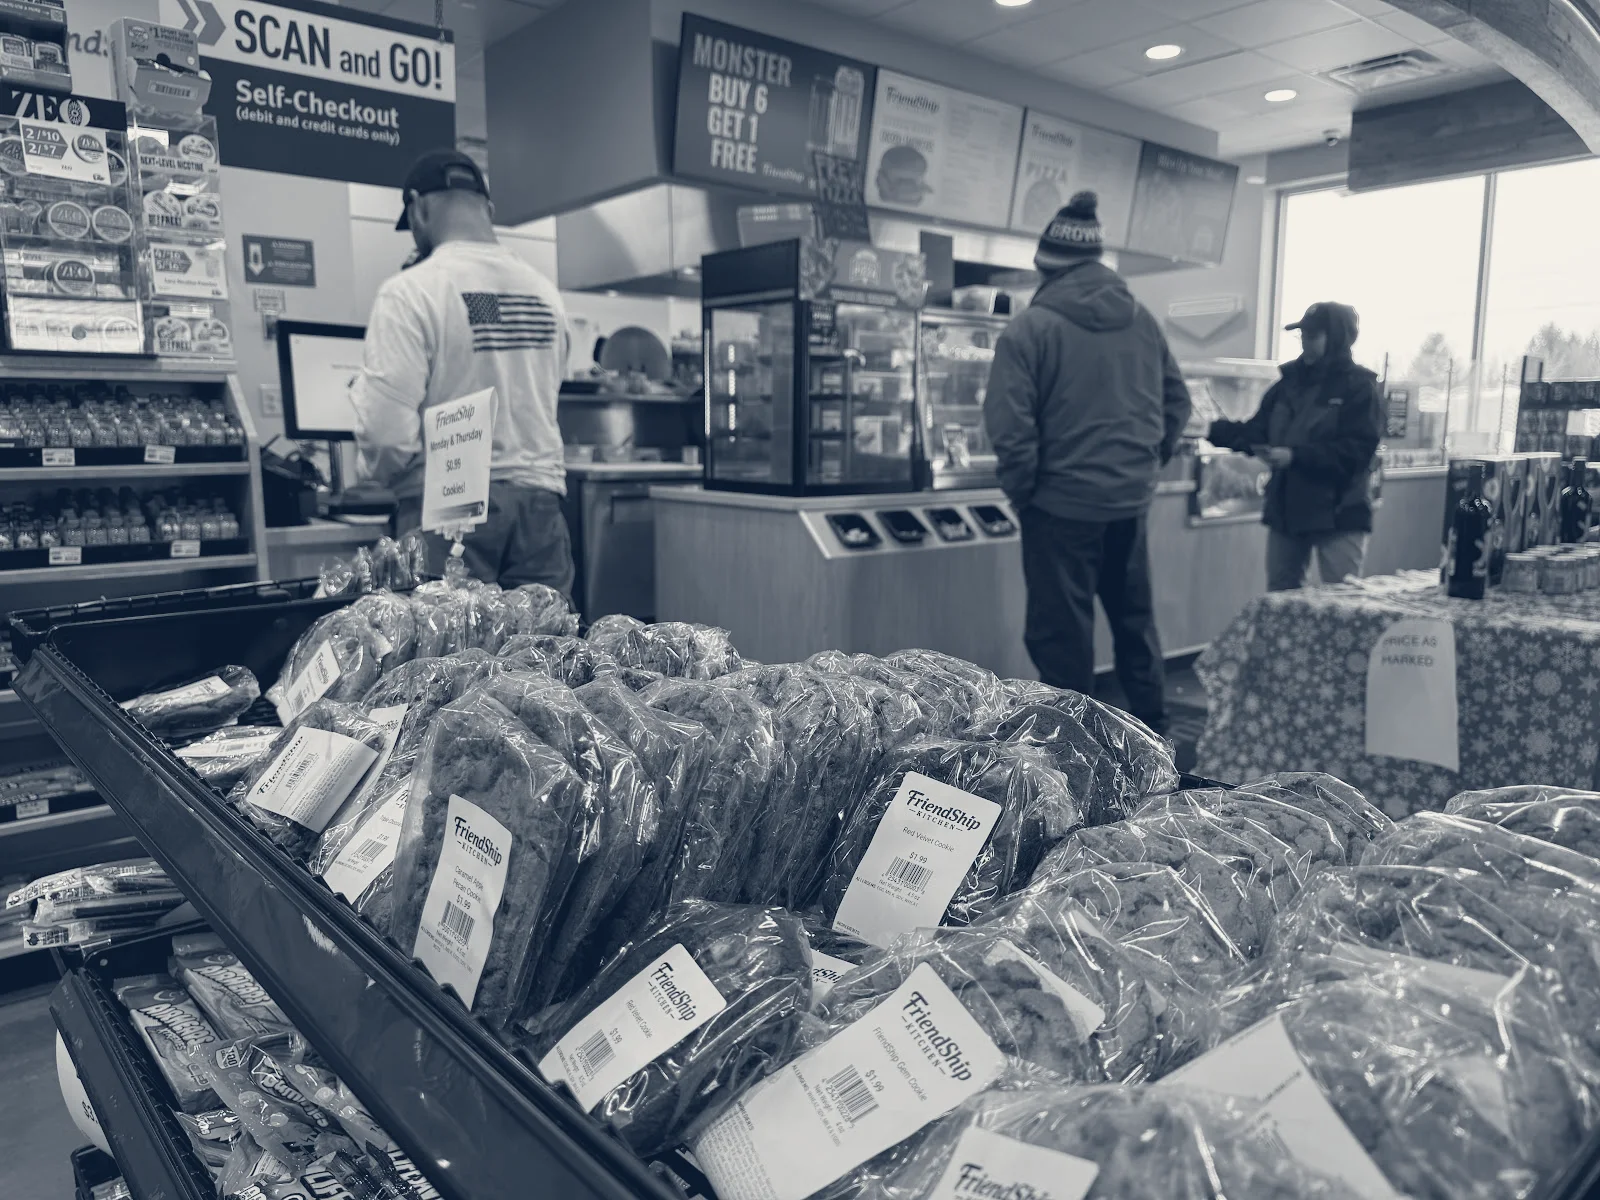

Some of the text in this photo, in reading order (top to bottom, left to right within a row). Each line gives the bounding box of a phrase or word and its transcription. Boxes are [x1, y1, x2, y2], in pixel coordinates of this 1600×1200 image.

[234, 9, 442, 90] SCAN and GO!
[693, 32, 792, 87] MONSTER
[236, 78, 400, 128] Self-Checkout
[708, 72, 768, 114] BUY 6
[886, 86, 940, 114] FriendShip
[236, 105, 400, 146] (debit and credit cards only)
[707, 105, 758, 144] GET 1
[177, 162, 204, 172] NICOTINE
[710, 138, 758, 174] FREE
[436, 404, 475, 430] FriendShip
[430, 430, 483, 453] Monday & Thursday
[442, 482, 466, 496] Cookies!
[1381, 654, 1434, 667] MARKED
[906, 789, 981, 830] FriendShip
[916, 810, 956, 830] KITCHEN
[454, 816, 502, 866] FriendShip
[902, 826, 955, 852] Red Velvet Cookie
[462, 844, 488, 866] KITCHEN
[908, 852, 928, 864] $1.99
[454, 866, 473, 884] Caramel
[456, 894, 472, 910] $1.99
[650, 986, 673, 1015] KITCHEN
[652, 962, 697, 1021] FriendShip
[139, 1003, 216, 1044] AIRHEADS
[625, 1000, 653, 1039] Red Velvet Cookie
[609, 1028, 624, 1045] $1.99
[902, 990, 972, 1082] FriendShip
[904, 1024, 939, 1068] KITCHEN
[872, 1026, 928, 1102] FriendShip Gem Cookie
[813, 1084, 823, 1096] Net
[865, 1069, 884, 1092] $1.99
[817, 1094, 833, 1112] Weight
